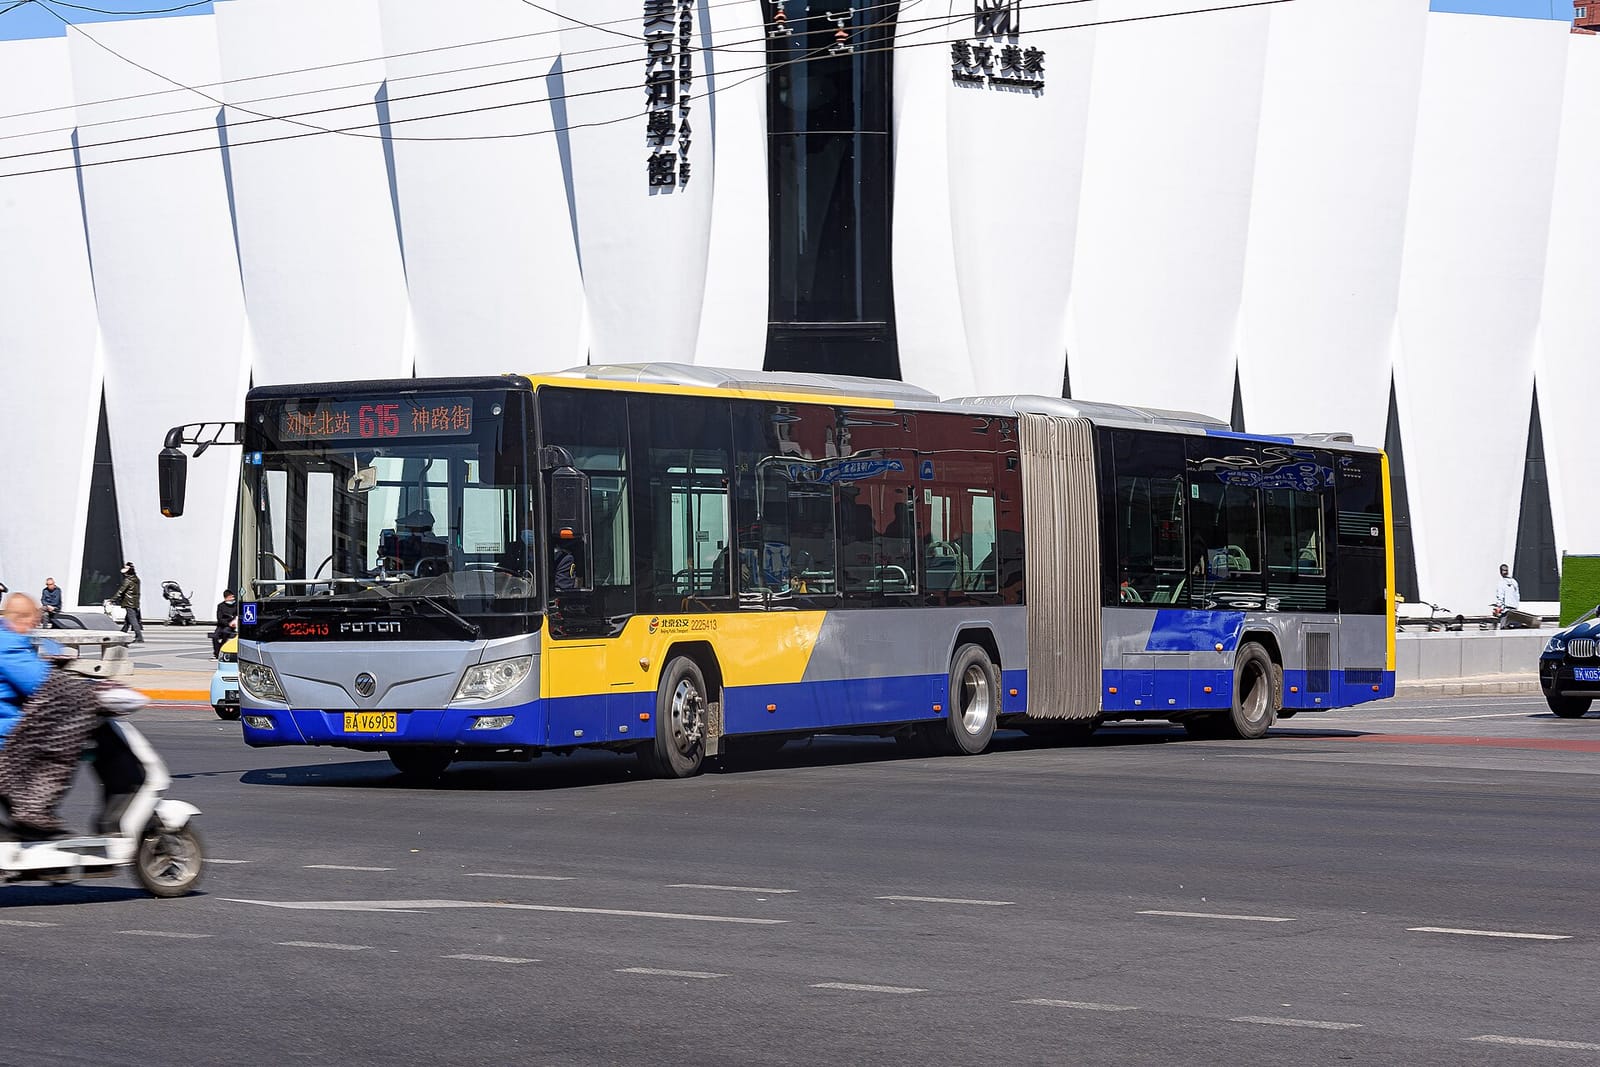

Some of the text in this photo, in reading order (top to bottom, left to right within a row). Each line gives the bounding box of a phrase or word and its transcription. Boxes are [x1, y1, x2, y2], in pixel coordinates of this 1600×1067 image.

[286, 404, 471, 438] 刘庄北站 615 神路街
[282, 622, 401, 636] 2225413 FOTON
[661, 619, 717, 631] 北京公交 2225413
